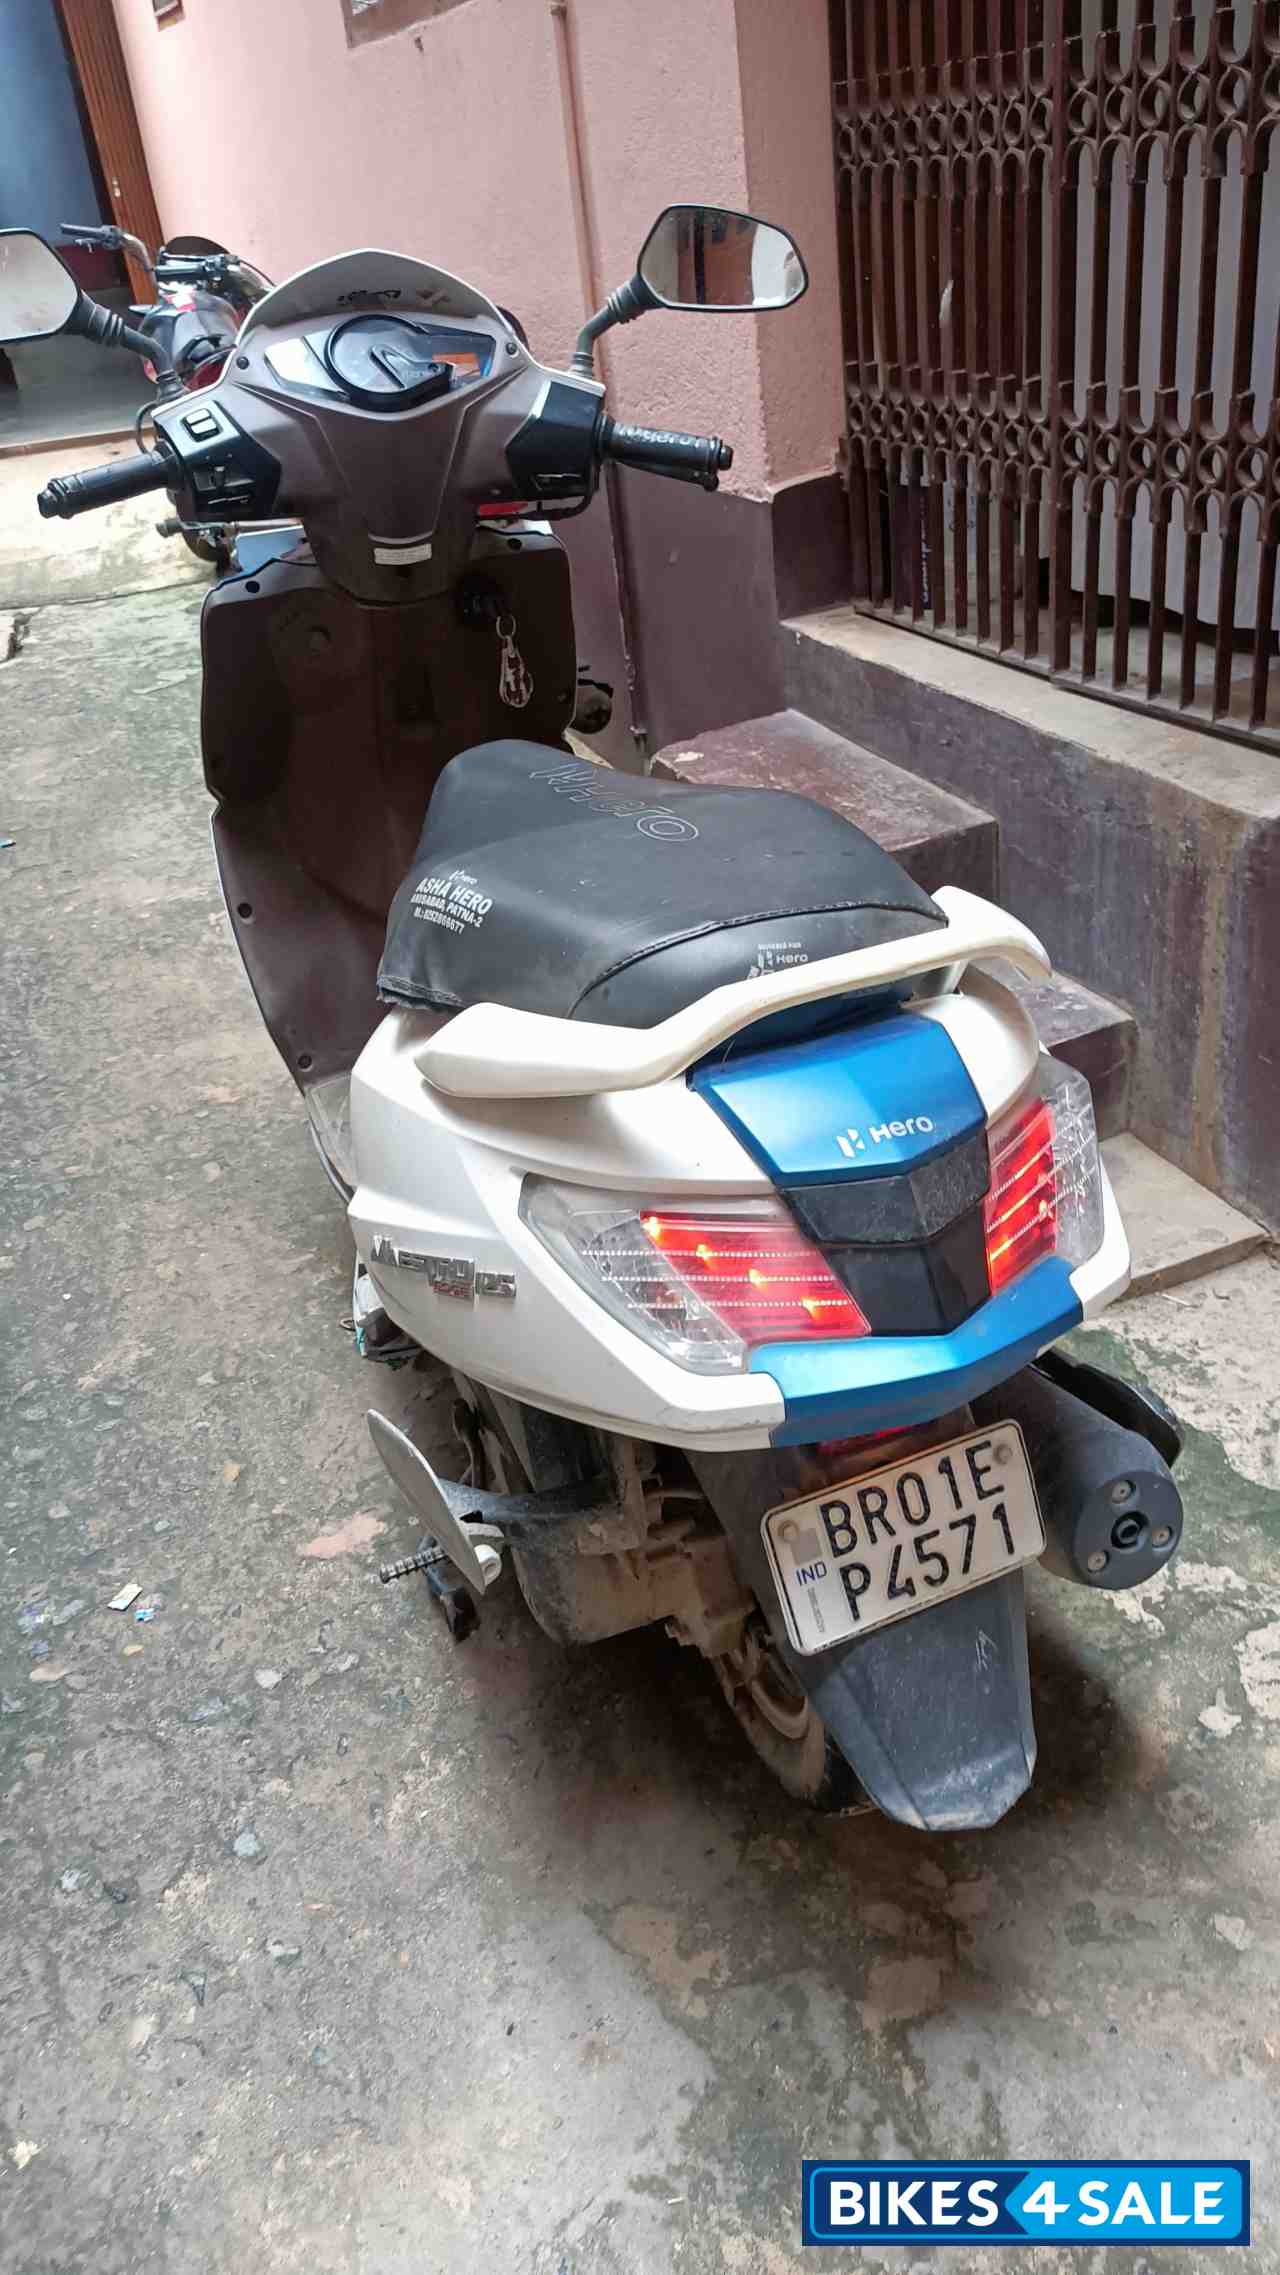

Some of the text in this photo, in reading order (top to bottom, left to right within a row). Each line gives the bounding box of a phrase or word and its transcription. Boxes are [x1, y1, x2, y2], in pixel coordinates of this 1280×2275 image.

[415, 877, 494, 915] ASHA HERO
[868, 1116, 934, 1144] Hero
[819, 1439, 1005, 1558] BR01E
[796, 1561, 828, 1586] IND
[839, 1502, 1015, 1622] P4571
